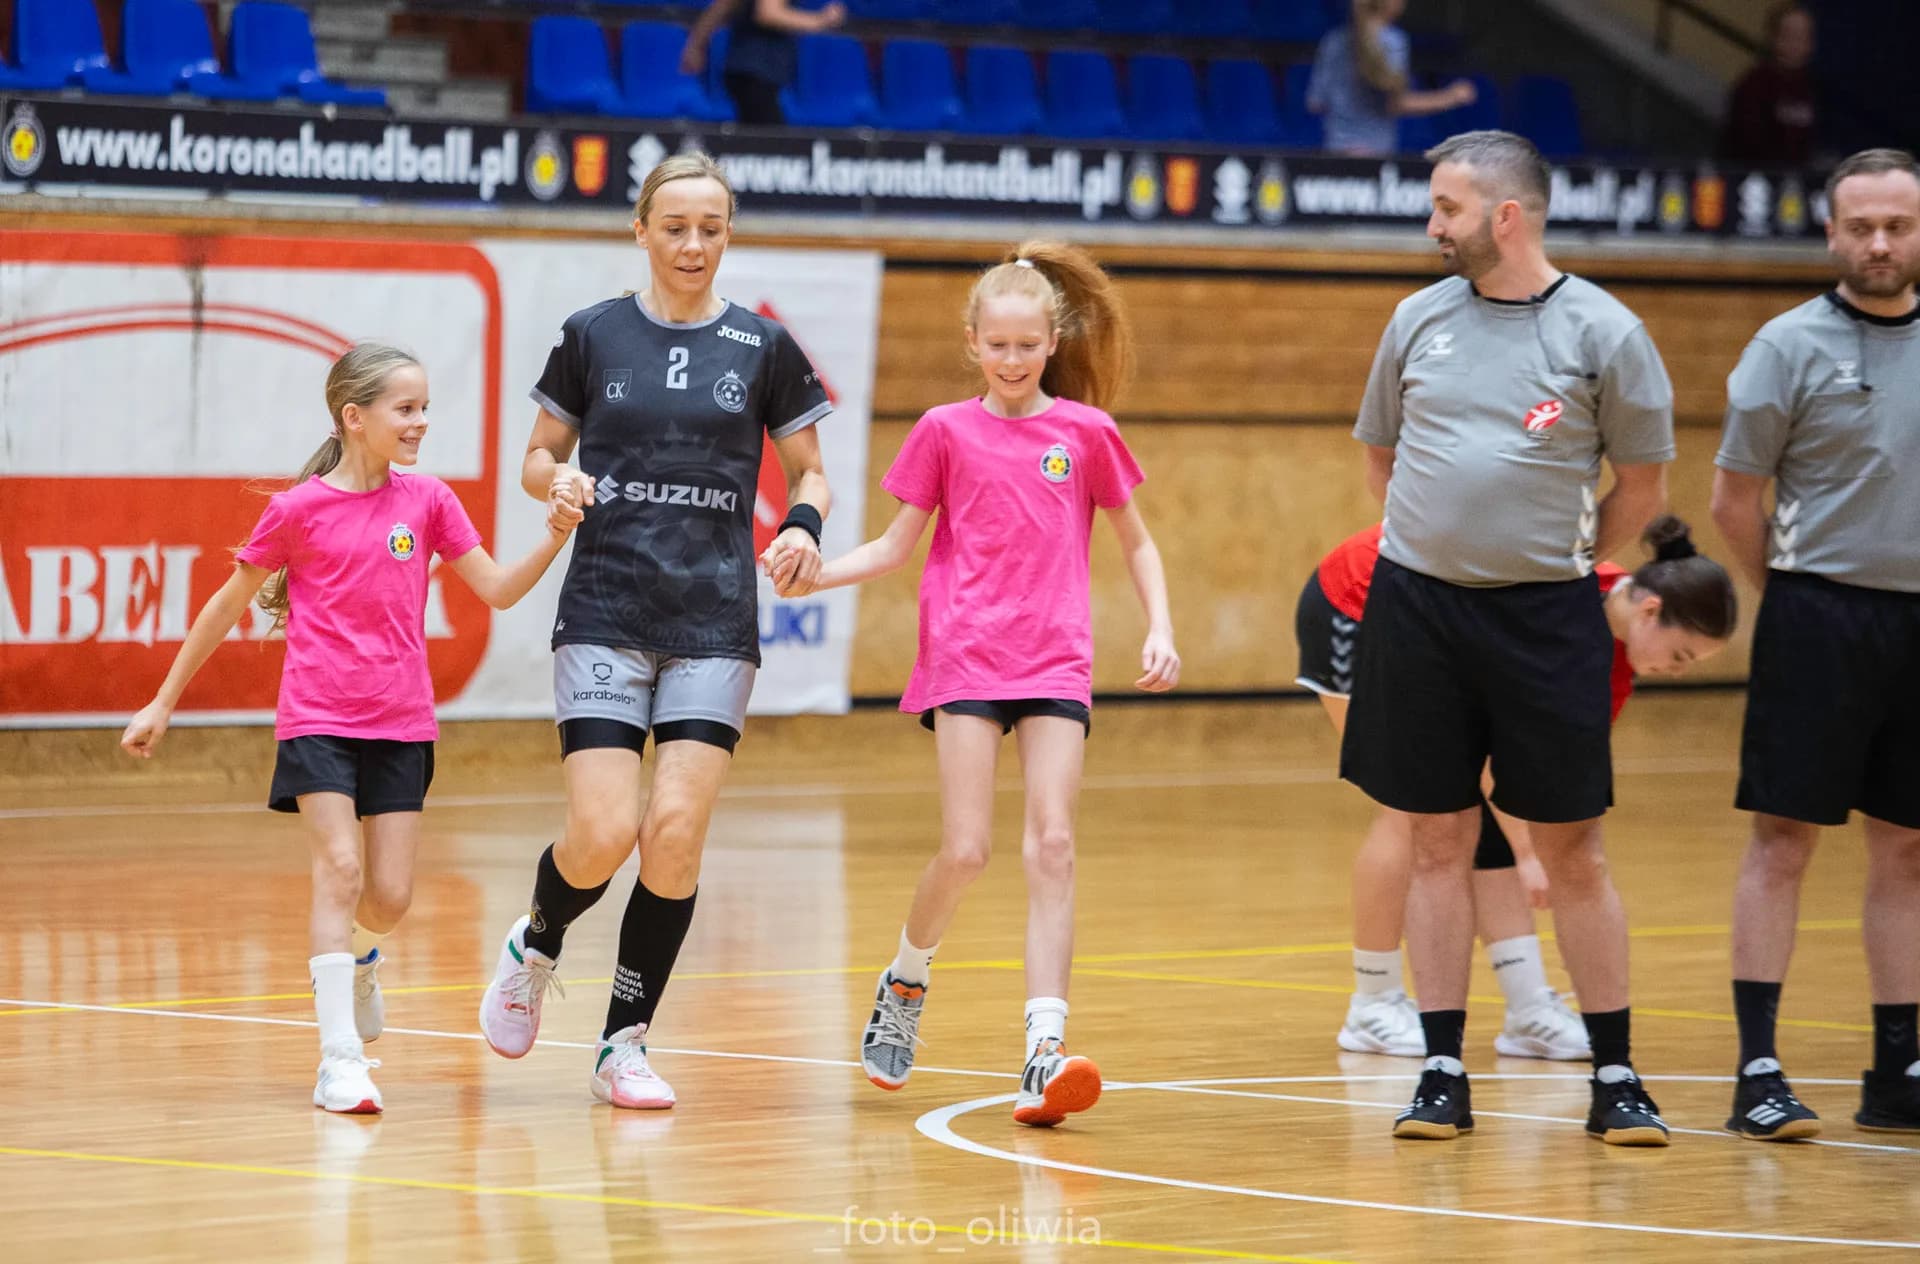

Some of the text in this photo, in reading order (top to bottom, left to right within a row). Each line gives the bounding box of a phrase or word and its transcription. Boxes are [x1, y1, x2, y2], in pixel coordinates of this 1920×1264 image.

[57, 113, 519, 201] www.koronahandball.pl
[716, 325, 762, 347] Joma
[666, 346, 689, 390] 2
[606, 381, 626, 399] CK
[623, 481, 738, 513] SUZUKI
